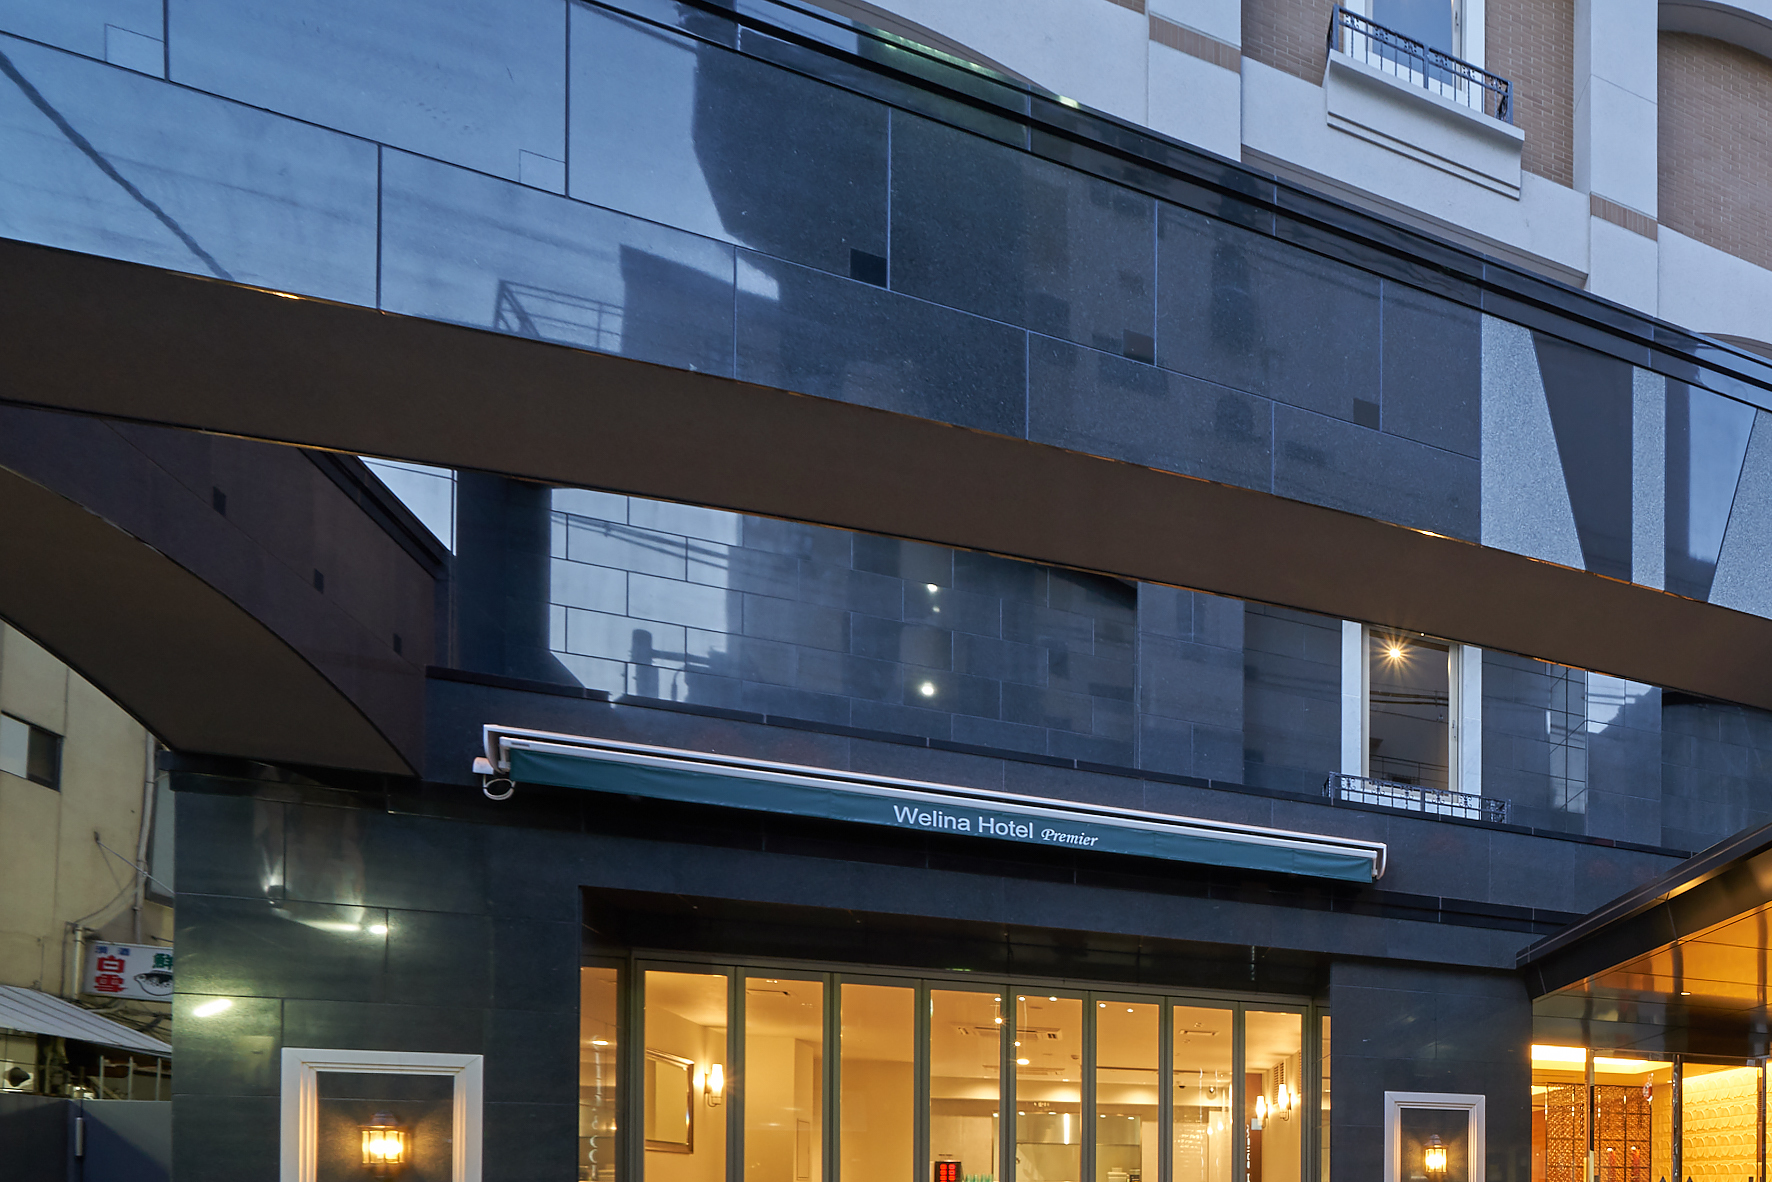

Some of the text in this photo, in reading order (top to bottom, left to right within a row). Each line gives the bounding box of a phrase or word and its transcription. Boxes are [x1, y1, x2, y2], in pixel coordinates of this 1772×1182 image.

[893, 804, 1099, 847] Welina Hotel Premier
